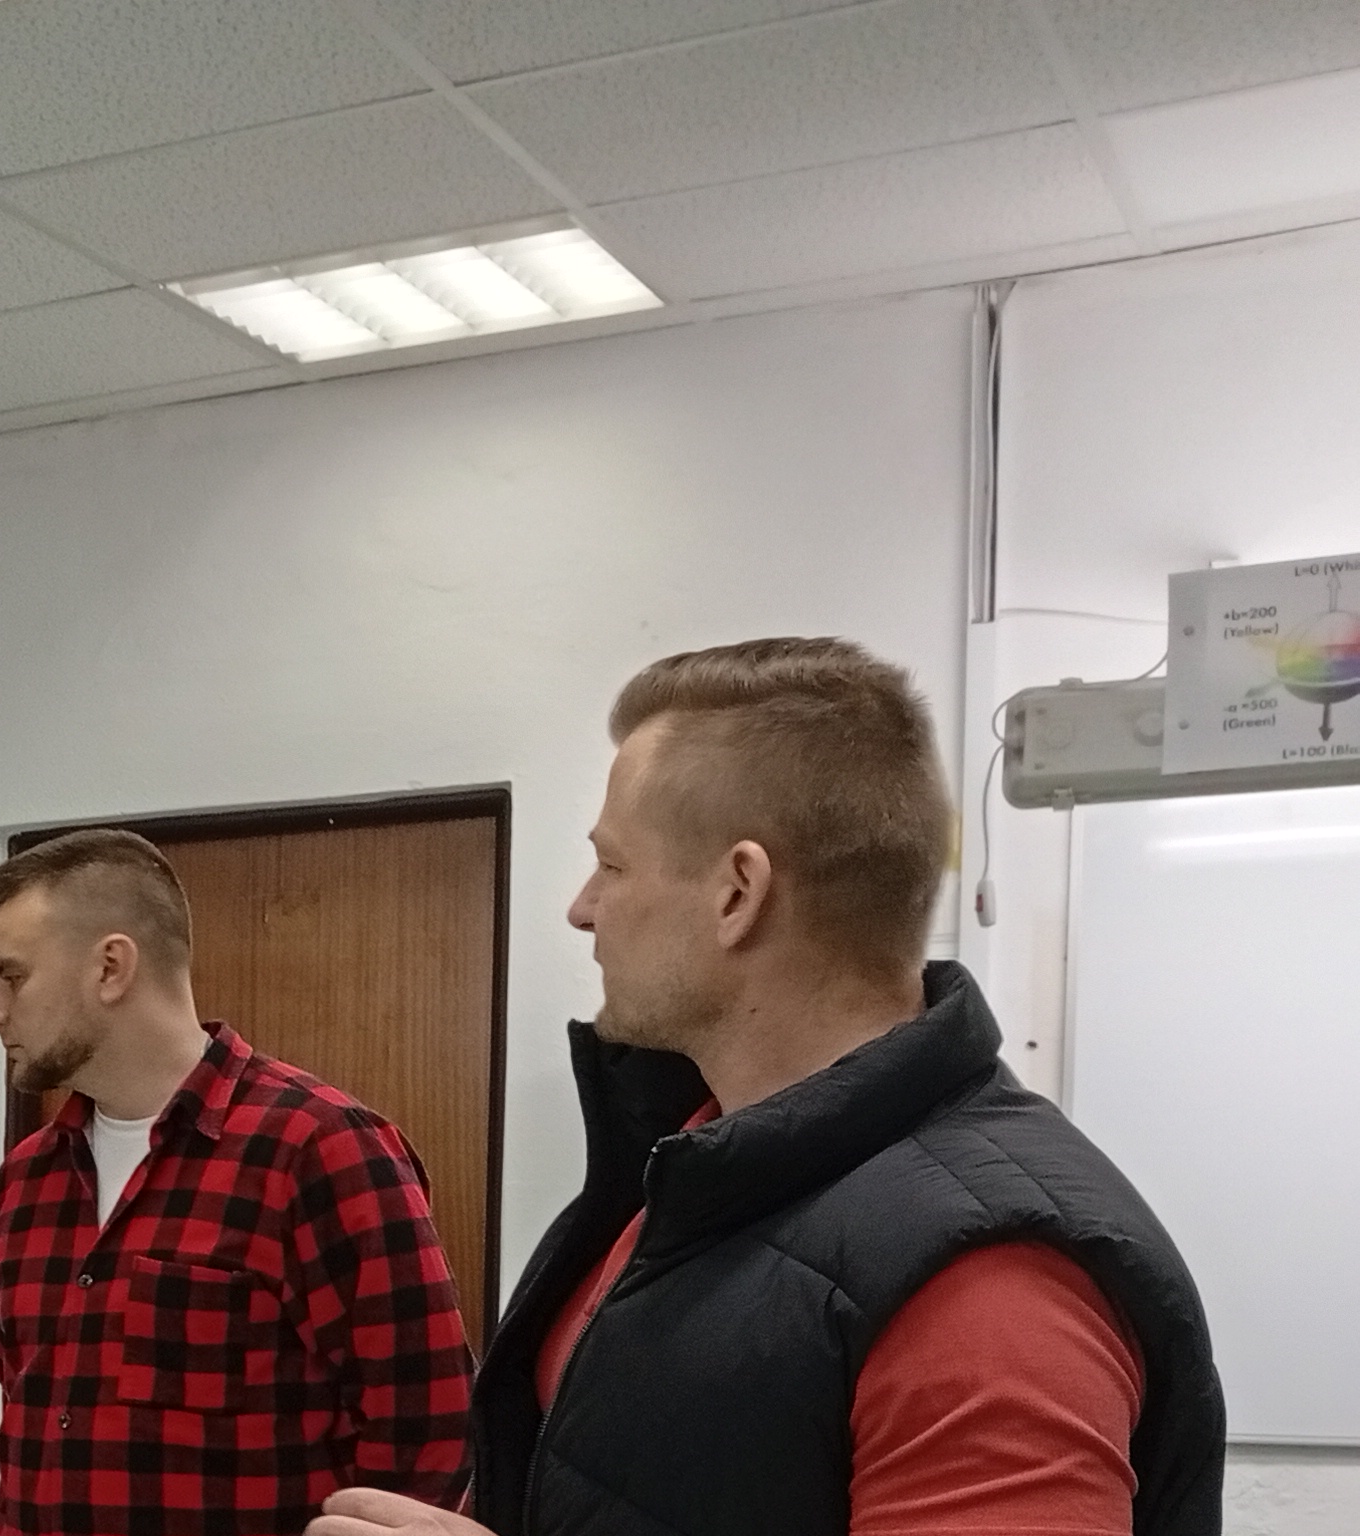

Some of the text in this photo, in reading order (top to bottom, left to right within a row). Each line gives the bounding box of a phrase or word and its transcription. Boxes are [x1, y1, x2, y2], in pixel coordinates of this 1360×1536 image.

[1294, 563, 1319, 577] L=0
[1224, 622, 1279, 639] (Yellow)
[1223, 714, 1276, 731] (Green)
[1282, 746, 1326, 759] L=100
